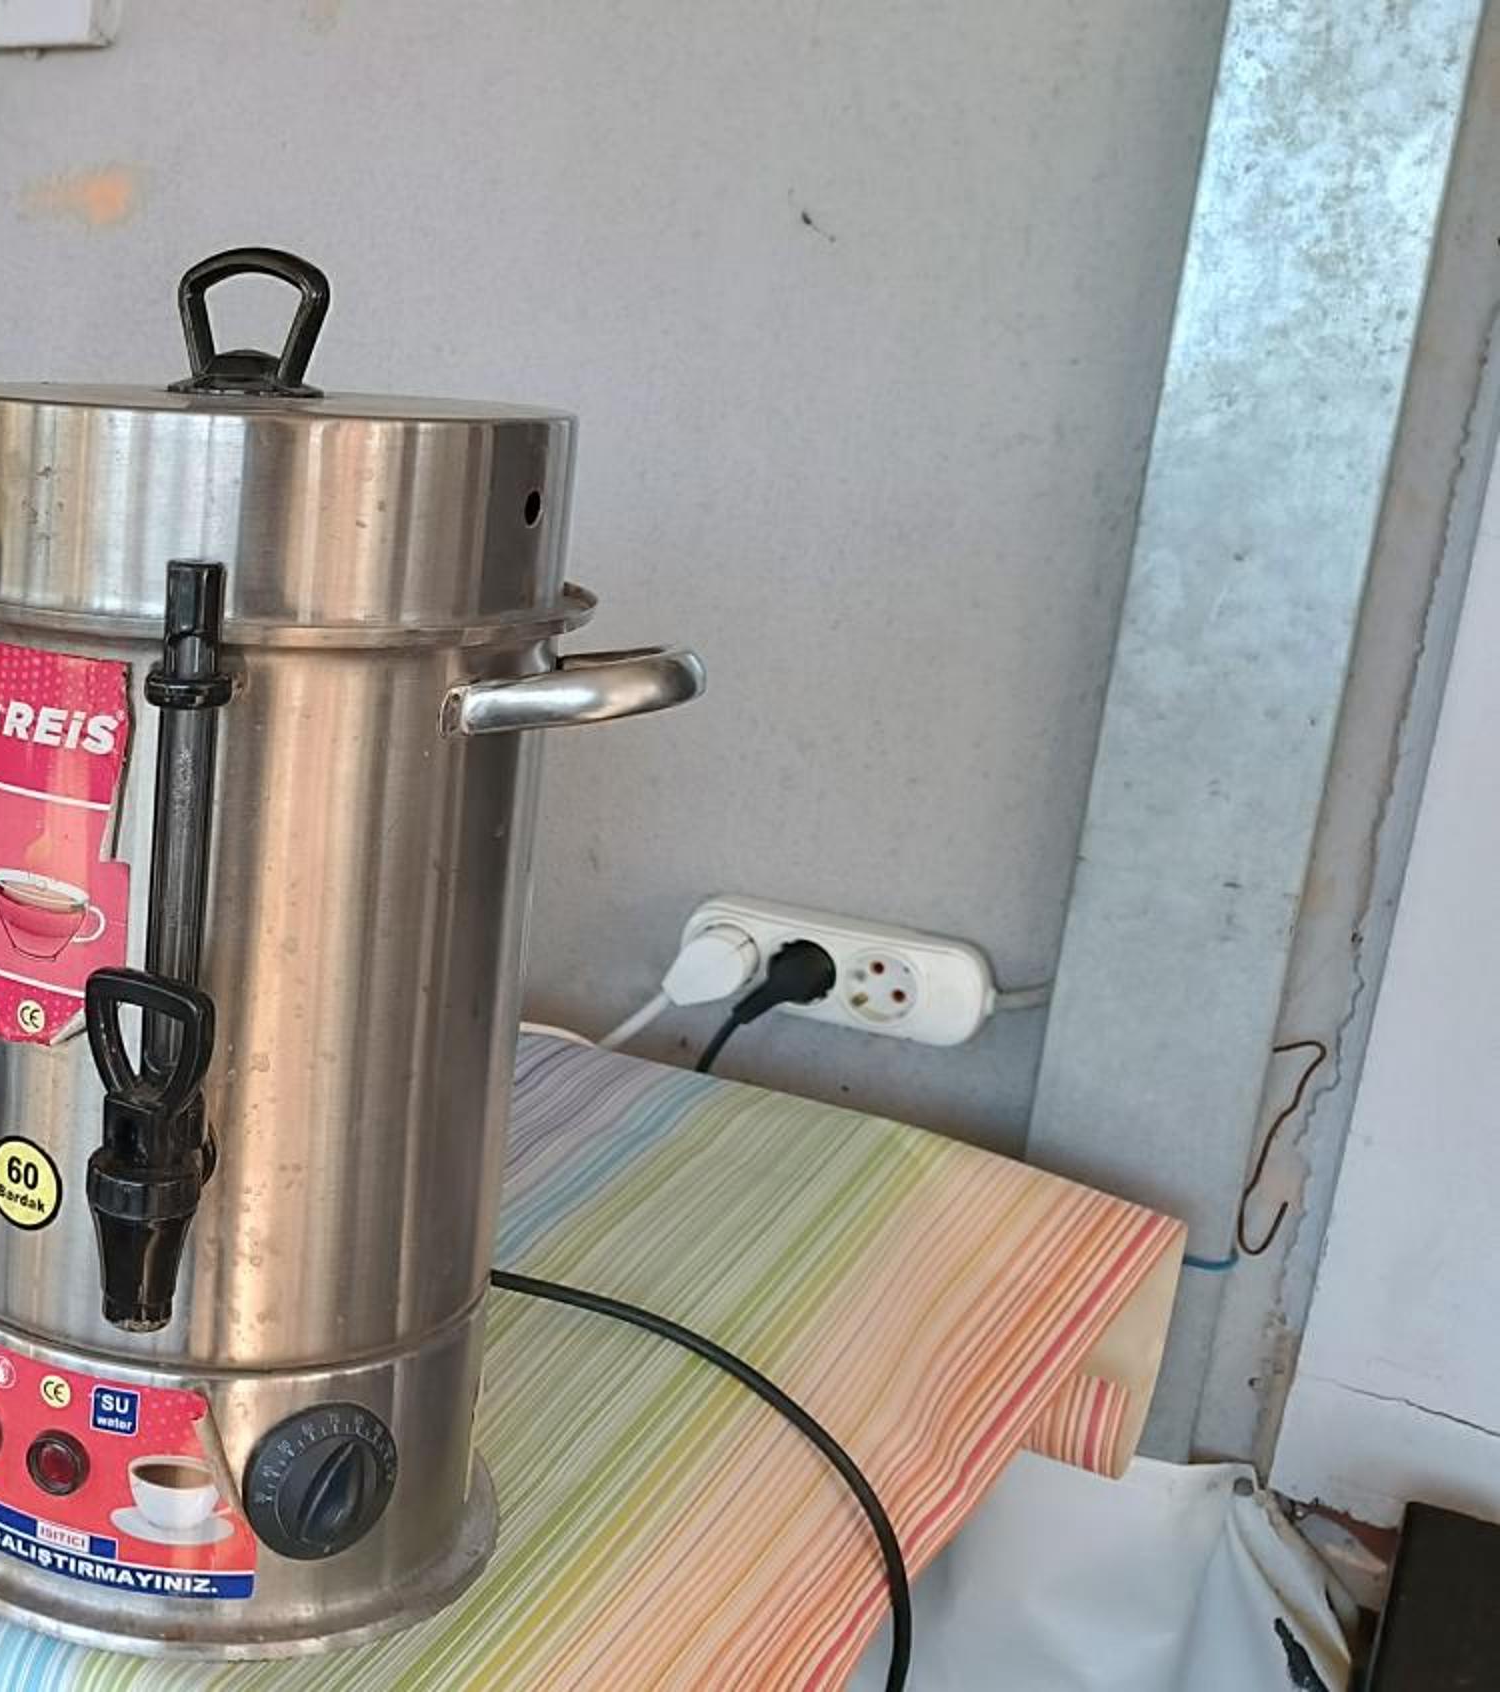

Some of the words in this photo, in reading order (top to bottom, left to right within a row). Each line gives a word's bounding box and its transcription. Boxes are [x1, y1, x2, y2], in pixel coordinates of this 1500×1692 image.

[20, 1004, 41, 1029] CE
[7, 1155, 39, 1190] 60
[43, 1380, 65, 1403] CE
[101, 1393, 130, 1414] SU
[97, 1416, 133, 1431] water
